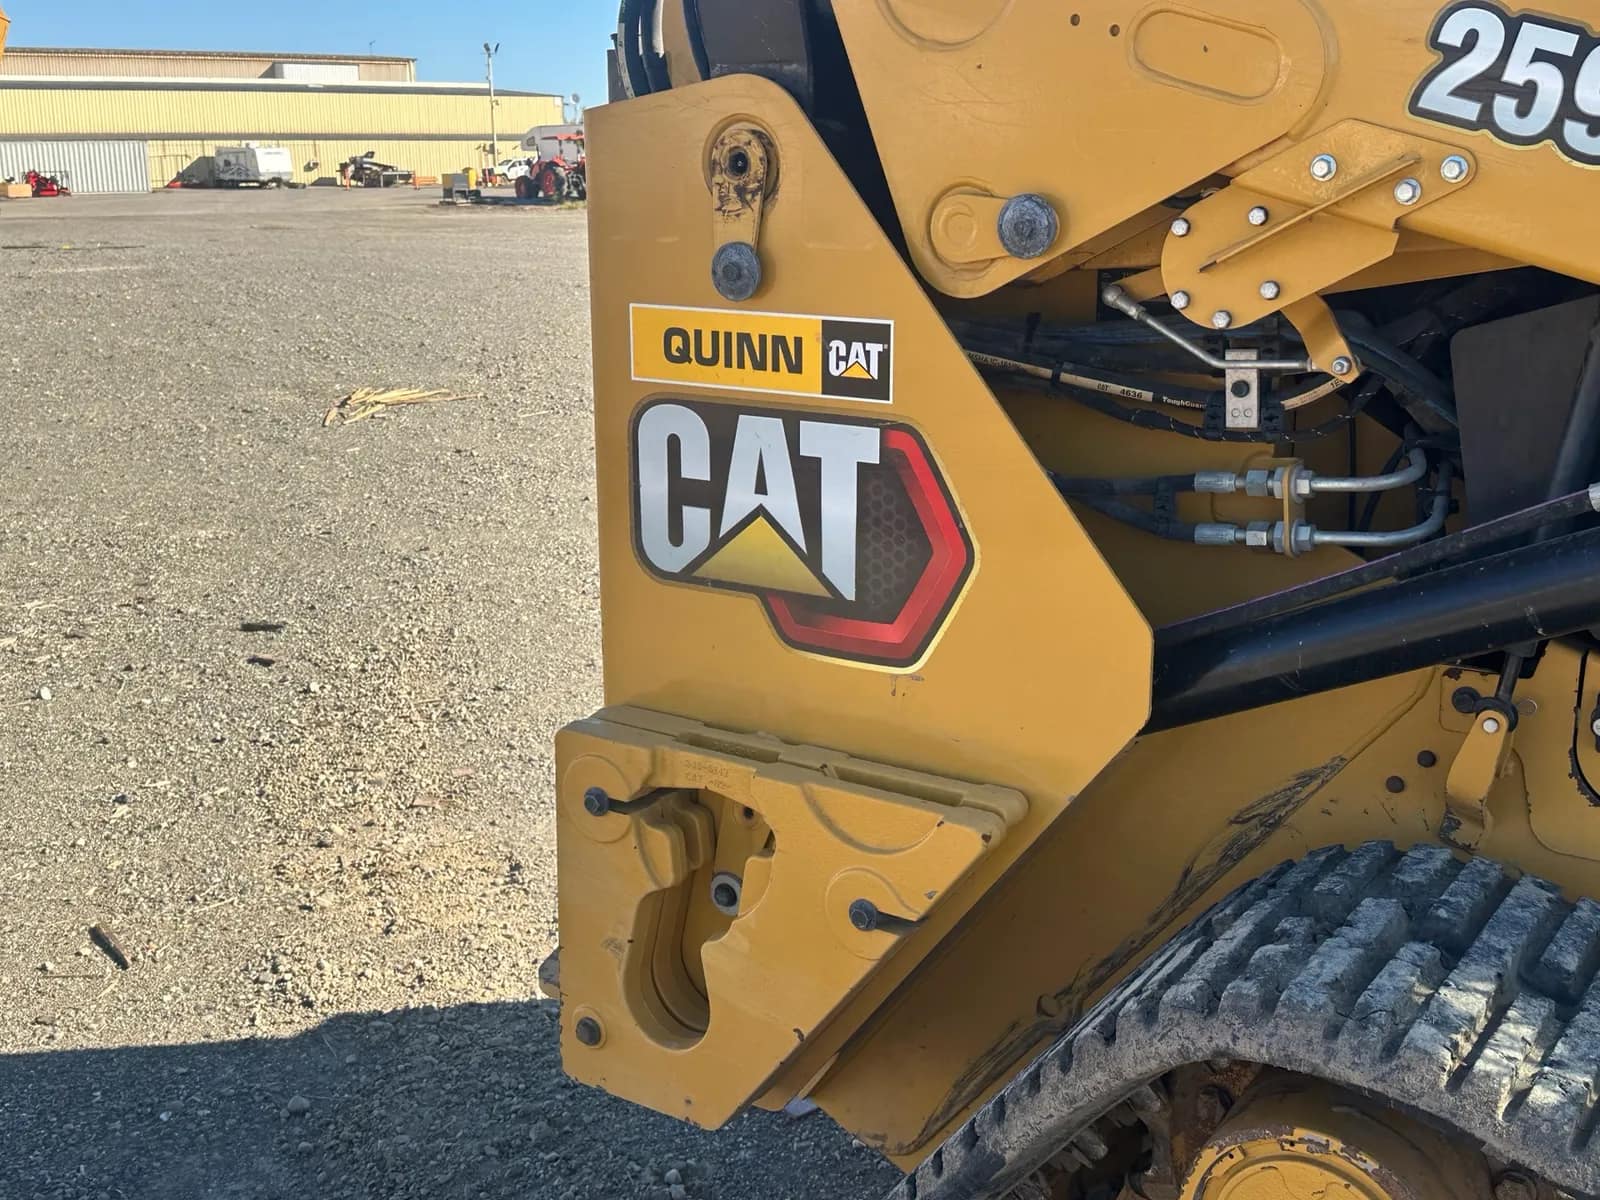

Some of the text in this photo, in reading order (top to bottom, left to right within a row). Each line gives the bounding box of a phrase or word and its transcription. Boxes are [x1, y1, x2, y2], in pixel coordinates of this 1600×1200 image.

[663, 327, 803, 374] QUINN
[828, 339, 884, 381] CAT
[1120, 388, 1143, 400] 4636
[637, 402, 881, 601] CAT
